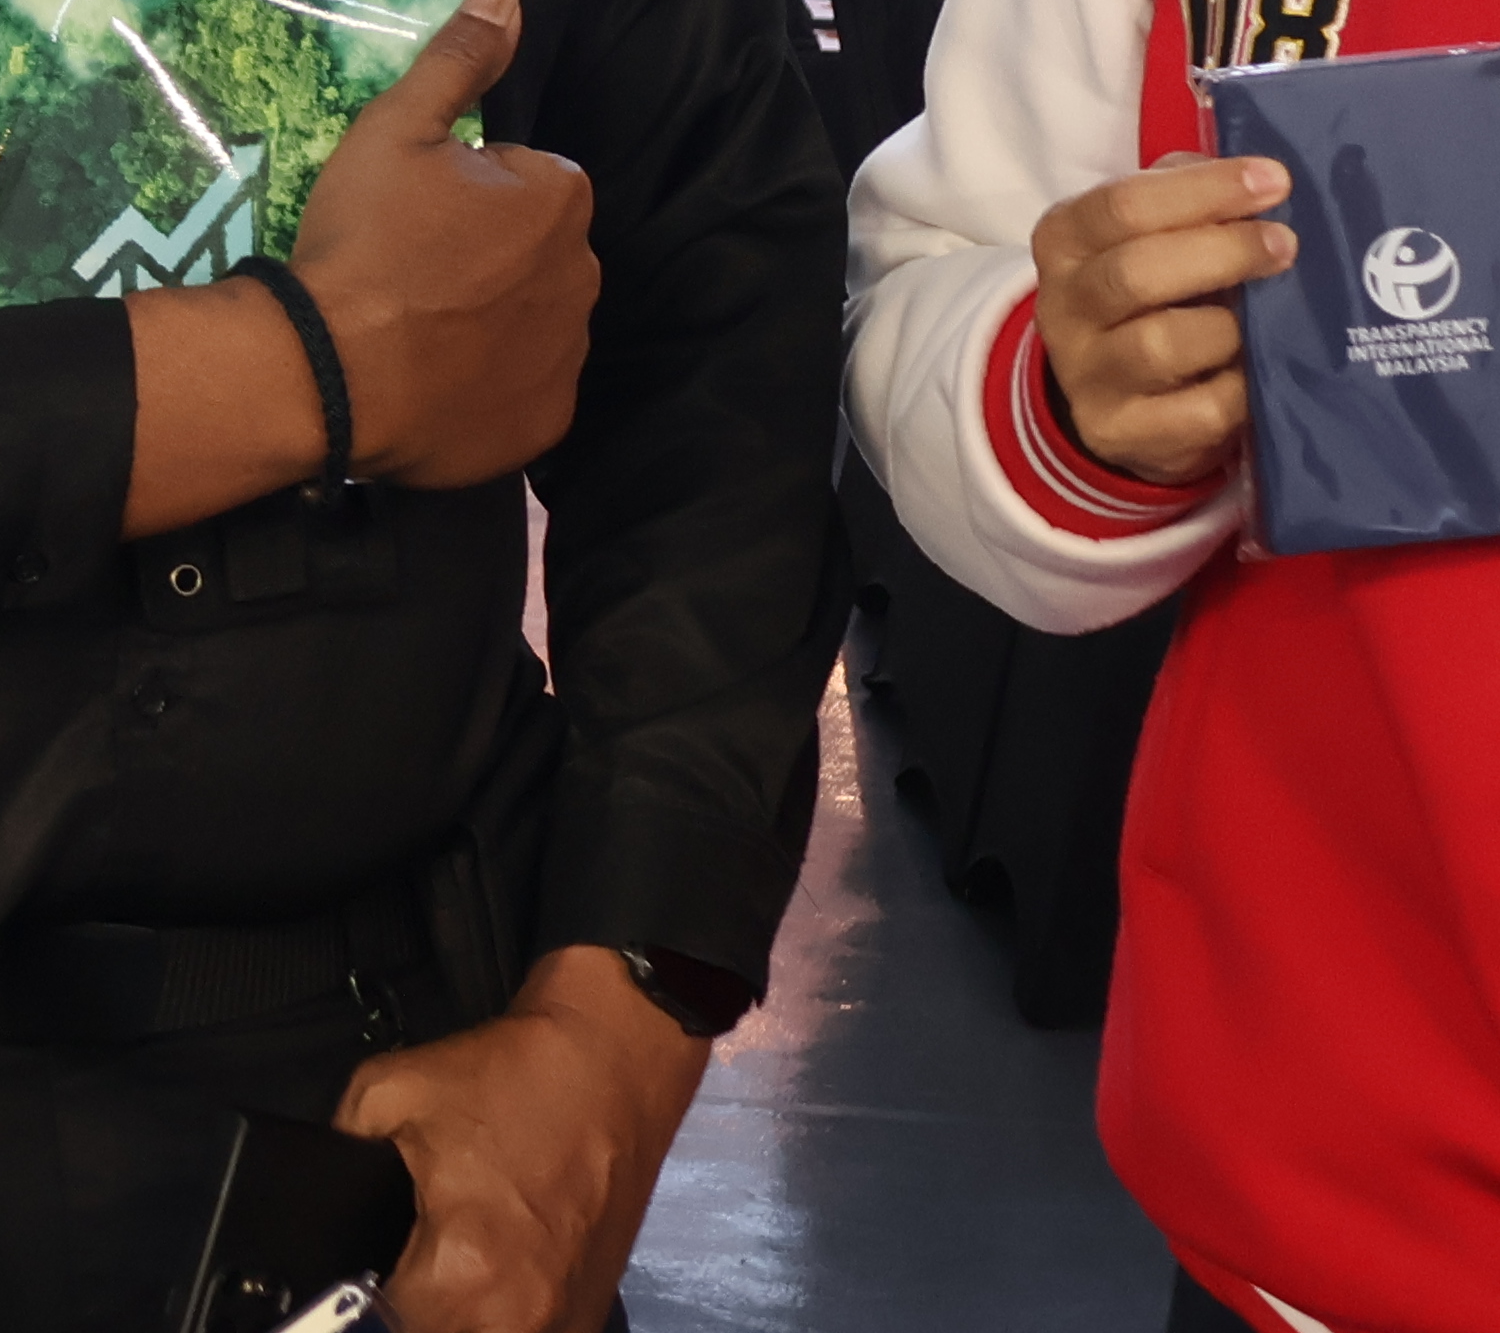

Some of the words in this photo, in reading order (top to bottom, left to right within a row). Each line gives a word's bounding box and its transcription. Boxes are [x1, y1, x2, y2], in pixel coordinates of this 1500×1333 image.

[1345, 317, 1489, 344] TRANSPARENCY
[1345, 334, 1494, 362] INTERNATIONAL
[1375, 353, 1471, 377] MALAYSIA
